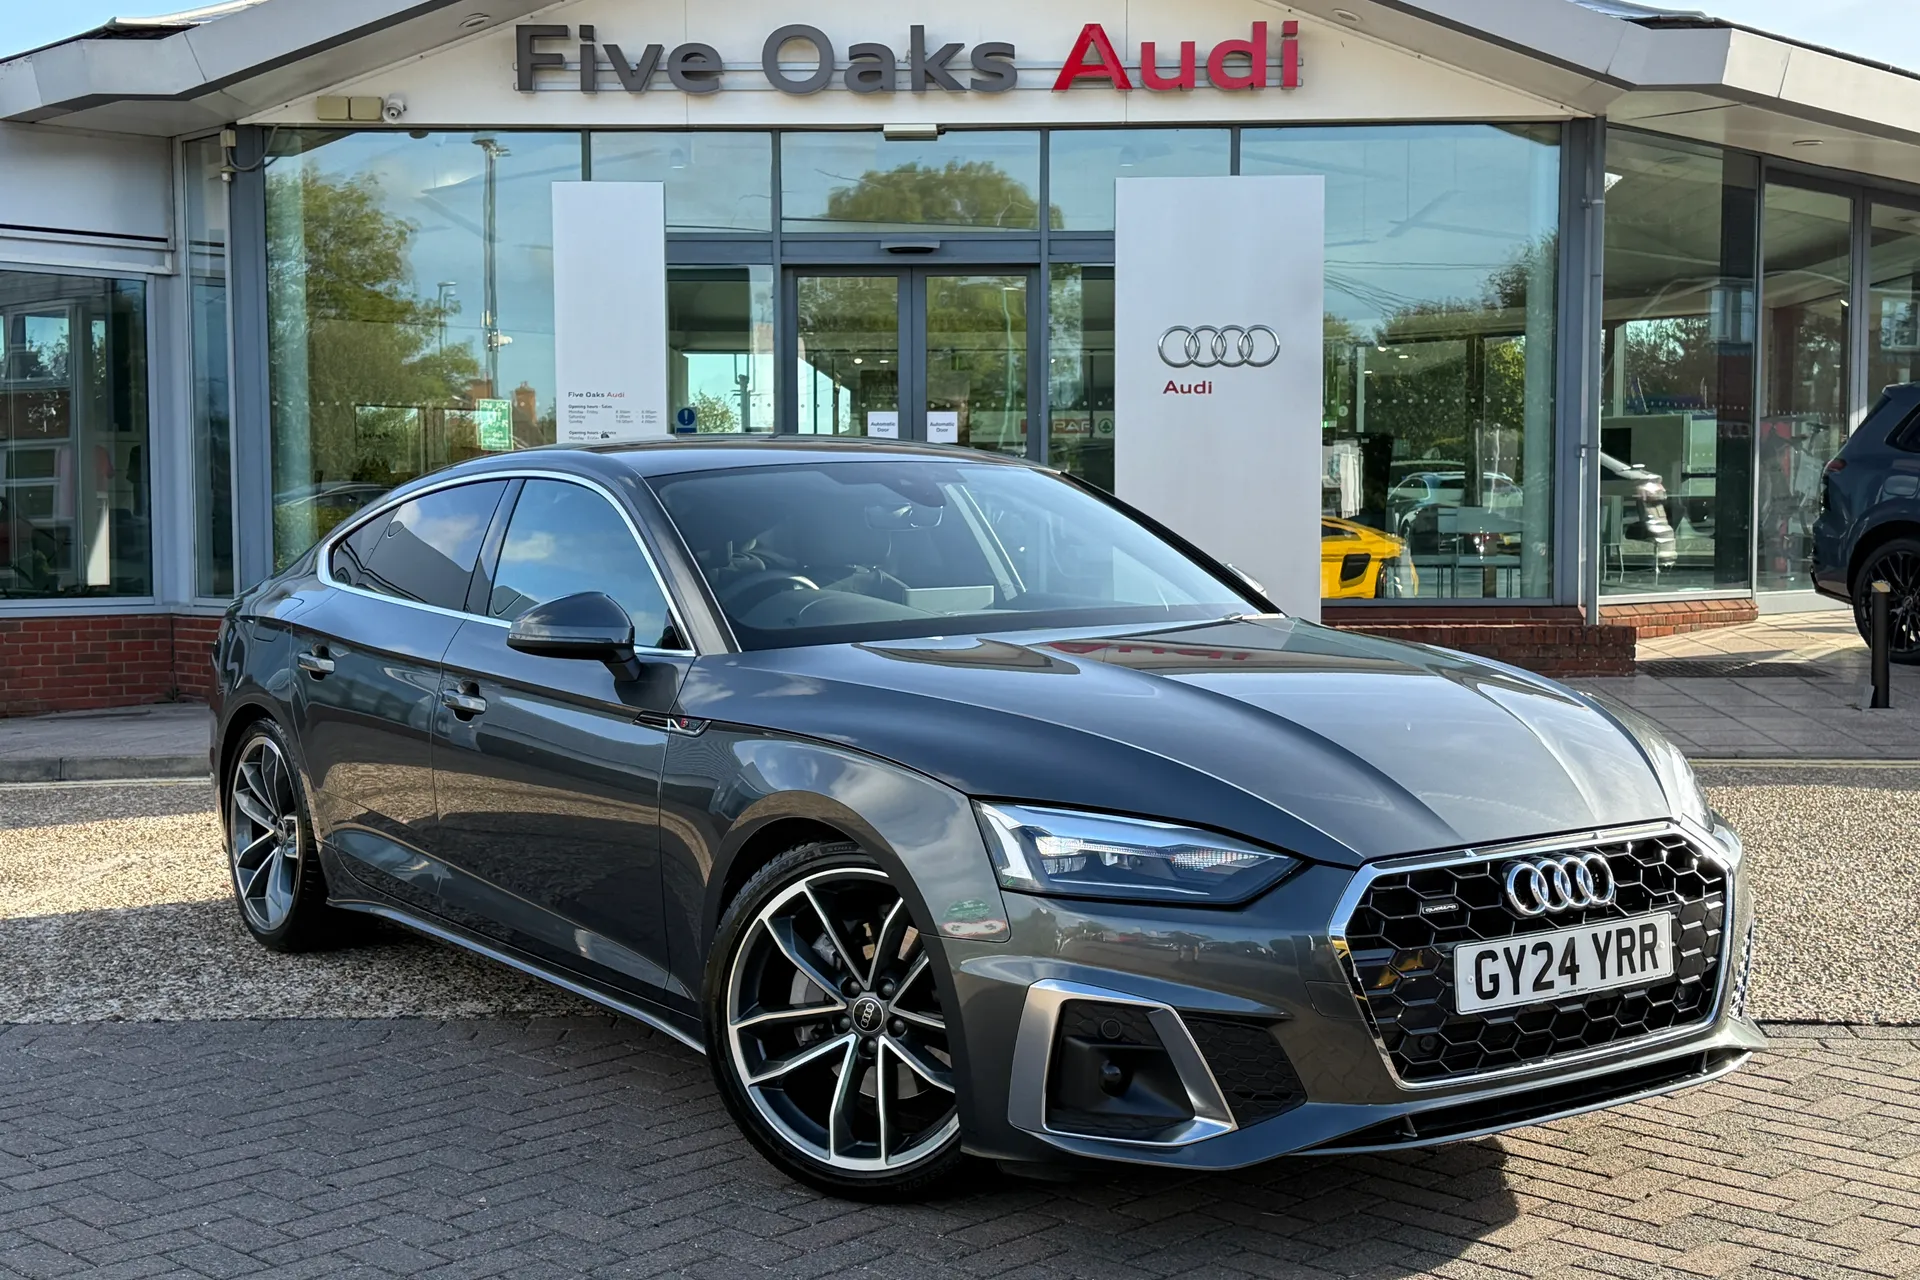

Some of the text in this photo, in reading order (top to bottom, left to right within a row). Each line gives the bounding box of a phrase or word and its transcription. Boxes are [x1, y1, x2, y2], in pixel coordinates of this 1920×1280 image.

[514, 20, 1299, 93] Five Oaks Audi
[1163, 380, 1212, 394] Audi
[1474, 922, 1659, 1001] GY24 YRR
